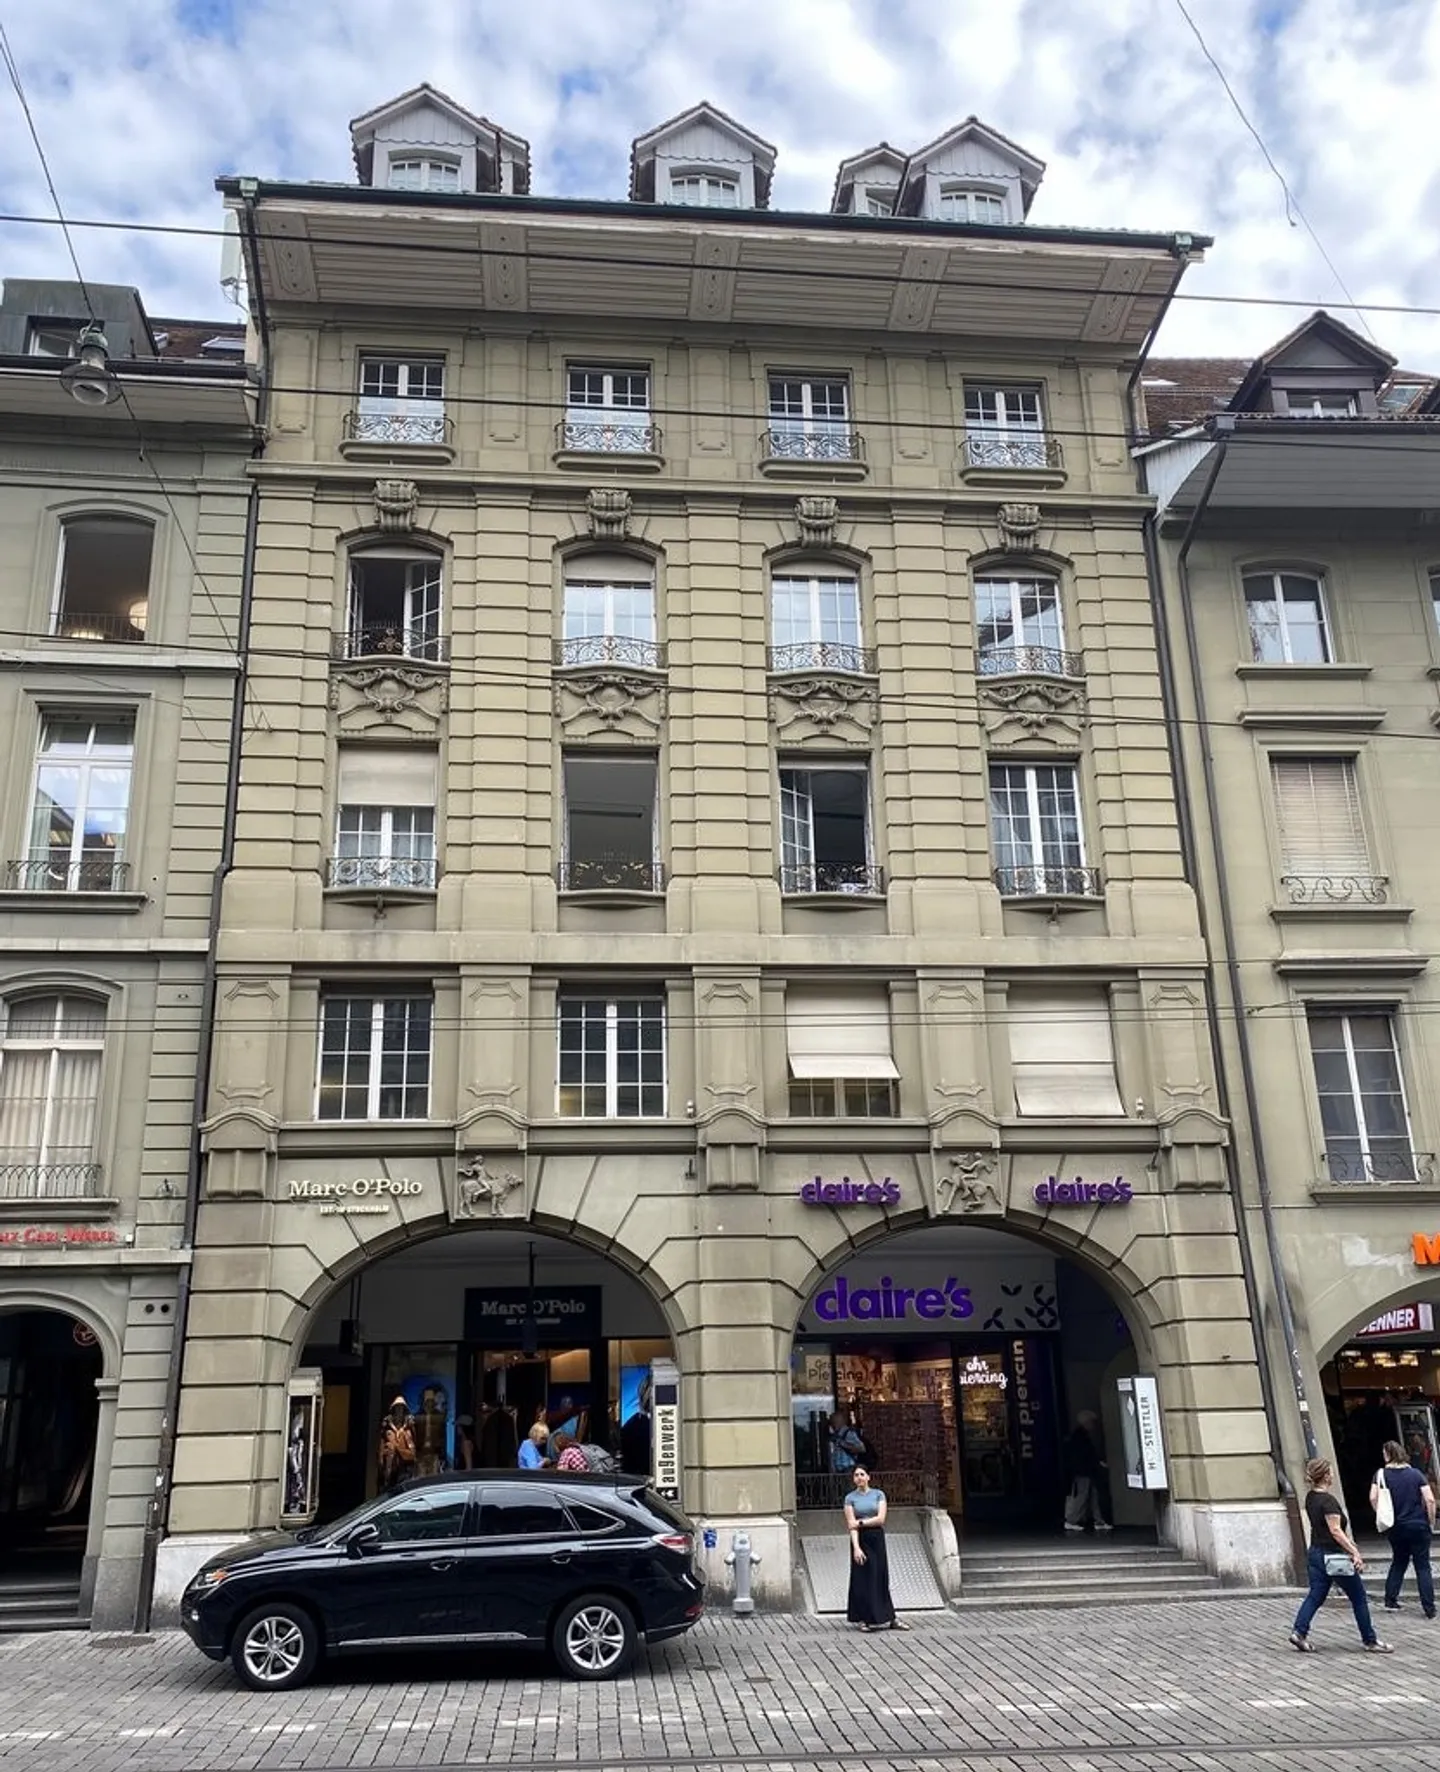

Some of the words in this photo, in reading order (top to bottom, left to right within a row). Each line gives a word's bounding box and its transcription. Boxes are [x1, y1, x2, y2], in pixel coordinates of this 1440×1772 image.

[287, 1180, 347, 1196] Marc
[352, 1178, 422, 1196] O'Polo
[801, 1176, 901, 1205] claire's
[1033, 1176, 1133, 1205] claire's
[481, 1301, 527, 1315] Marc
[815, 1276, 975, 1321] claire's
[1359, 1308, 1415, 1333] ENNER
[808, 1368, 863, 1382] Piecing
[658, 1408, 675, 1483] augenwerk
